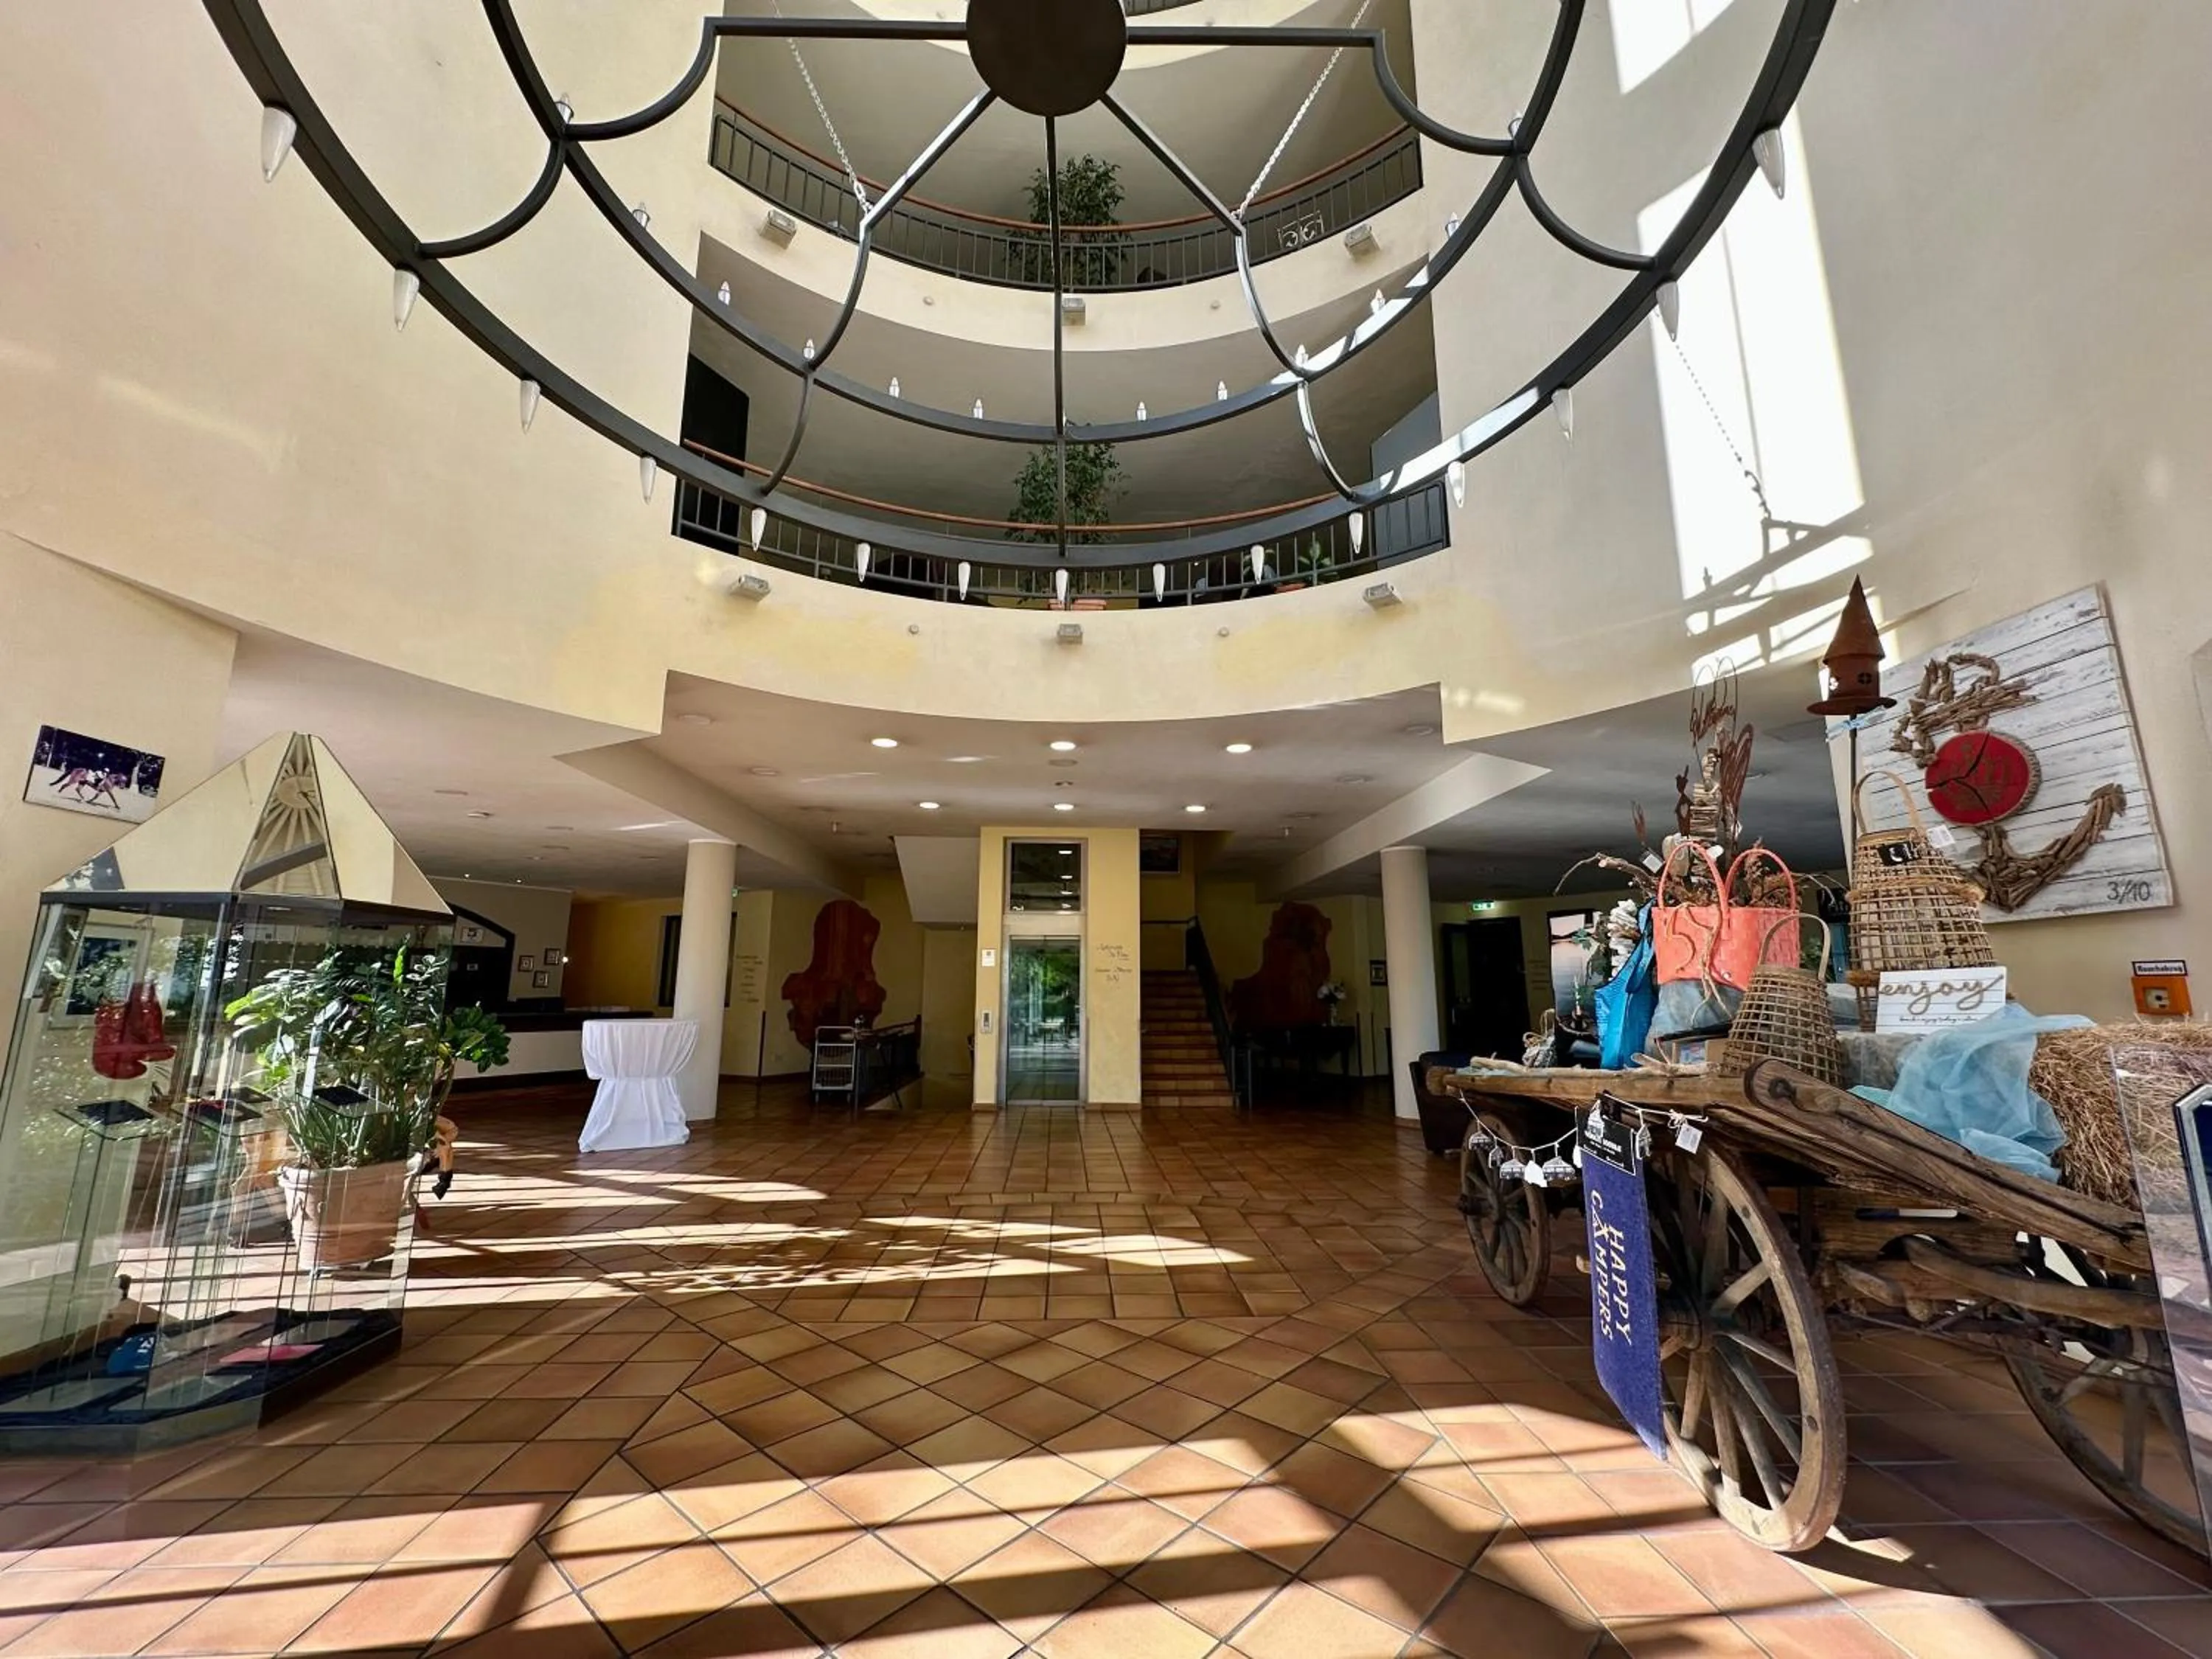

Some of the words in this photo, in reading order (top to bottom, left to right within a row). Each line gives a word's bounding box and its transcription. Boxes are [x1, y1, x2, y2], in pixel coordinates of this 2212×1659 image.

[2107, 880, 2151, 904] 3/10
[1878, 974, 2004, 1015] enjoy
[1591, 1189, 1613, 1342] CAMPERS
[1608, 1224, 1632, 1346] HAPPY
